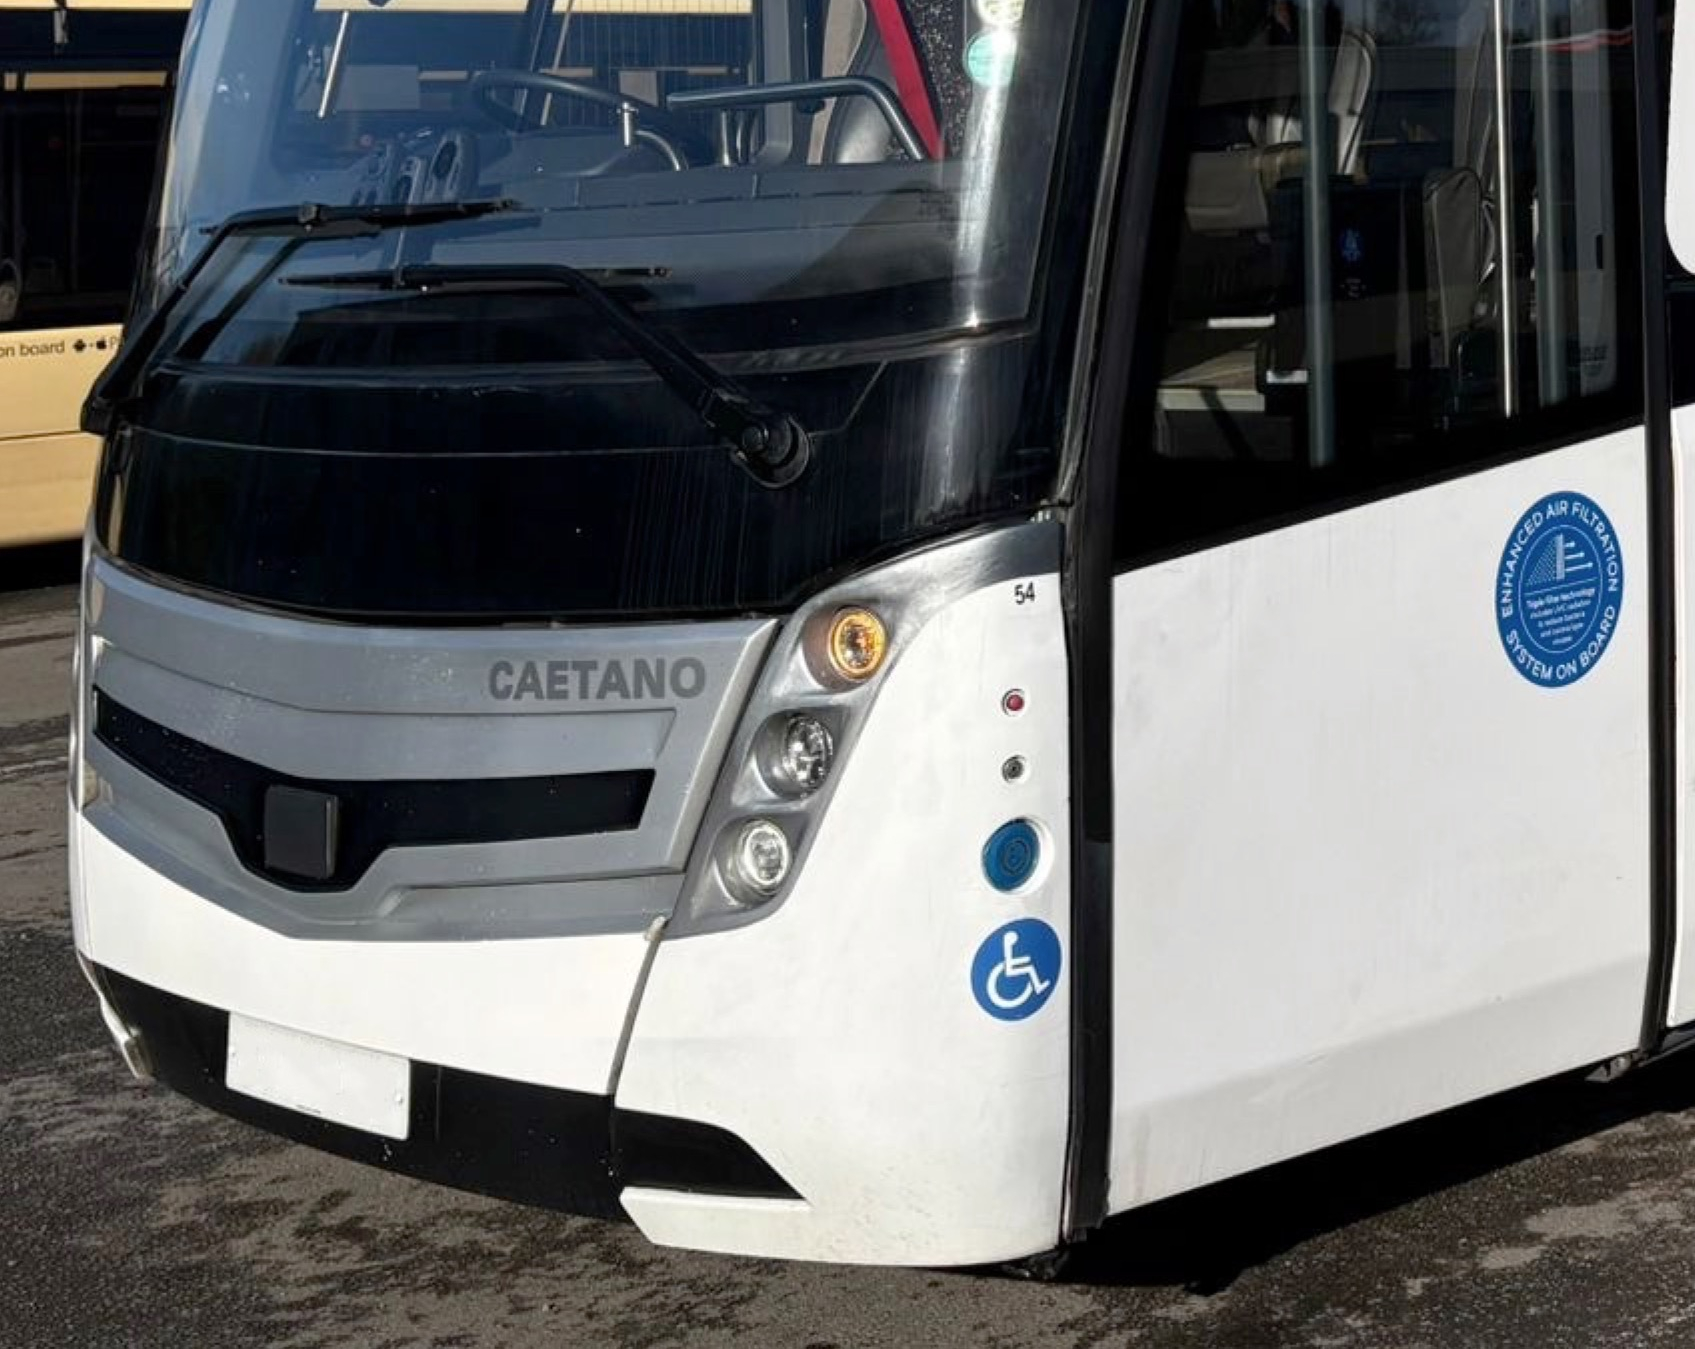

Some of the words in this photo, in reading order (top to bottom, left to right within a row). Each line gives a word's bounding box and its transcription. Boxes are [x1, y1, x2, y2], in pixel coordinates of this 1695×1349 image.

[20, 340, 65, 356] board
[1501, 512, 1543, 618] ENHANCED
[1546, 500, 1569, 520] AIR
[1571, 502, 1619, 593] FILTRATION
[1014, 581, 1036, 605] 54
[1506, 628, 1552, 680] SYSTEM
[1556, 659, 1578, 680] ON
[1580, 605, 1615, 668] BOARD
[488, 657, 707, 700] CAETANO
